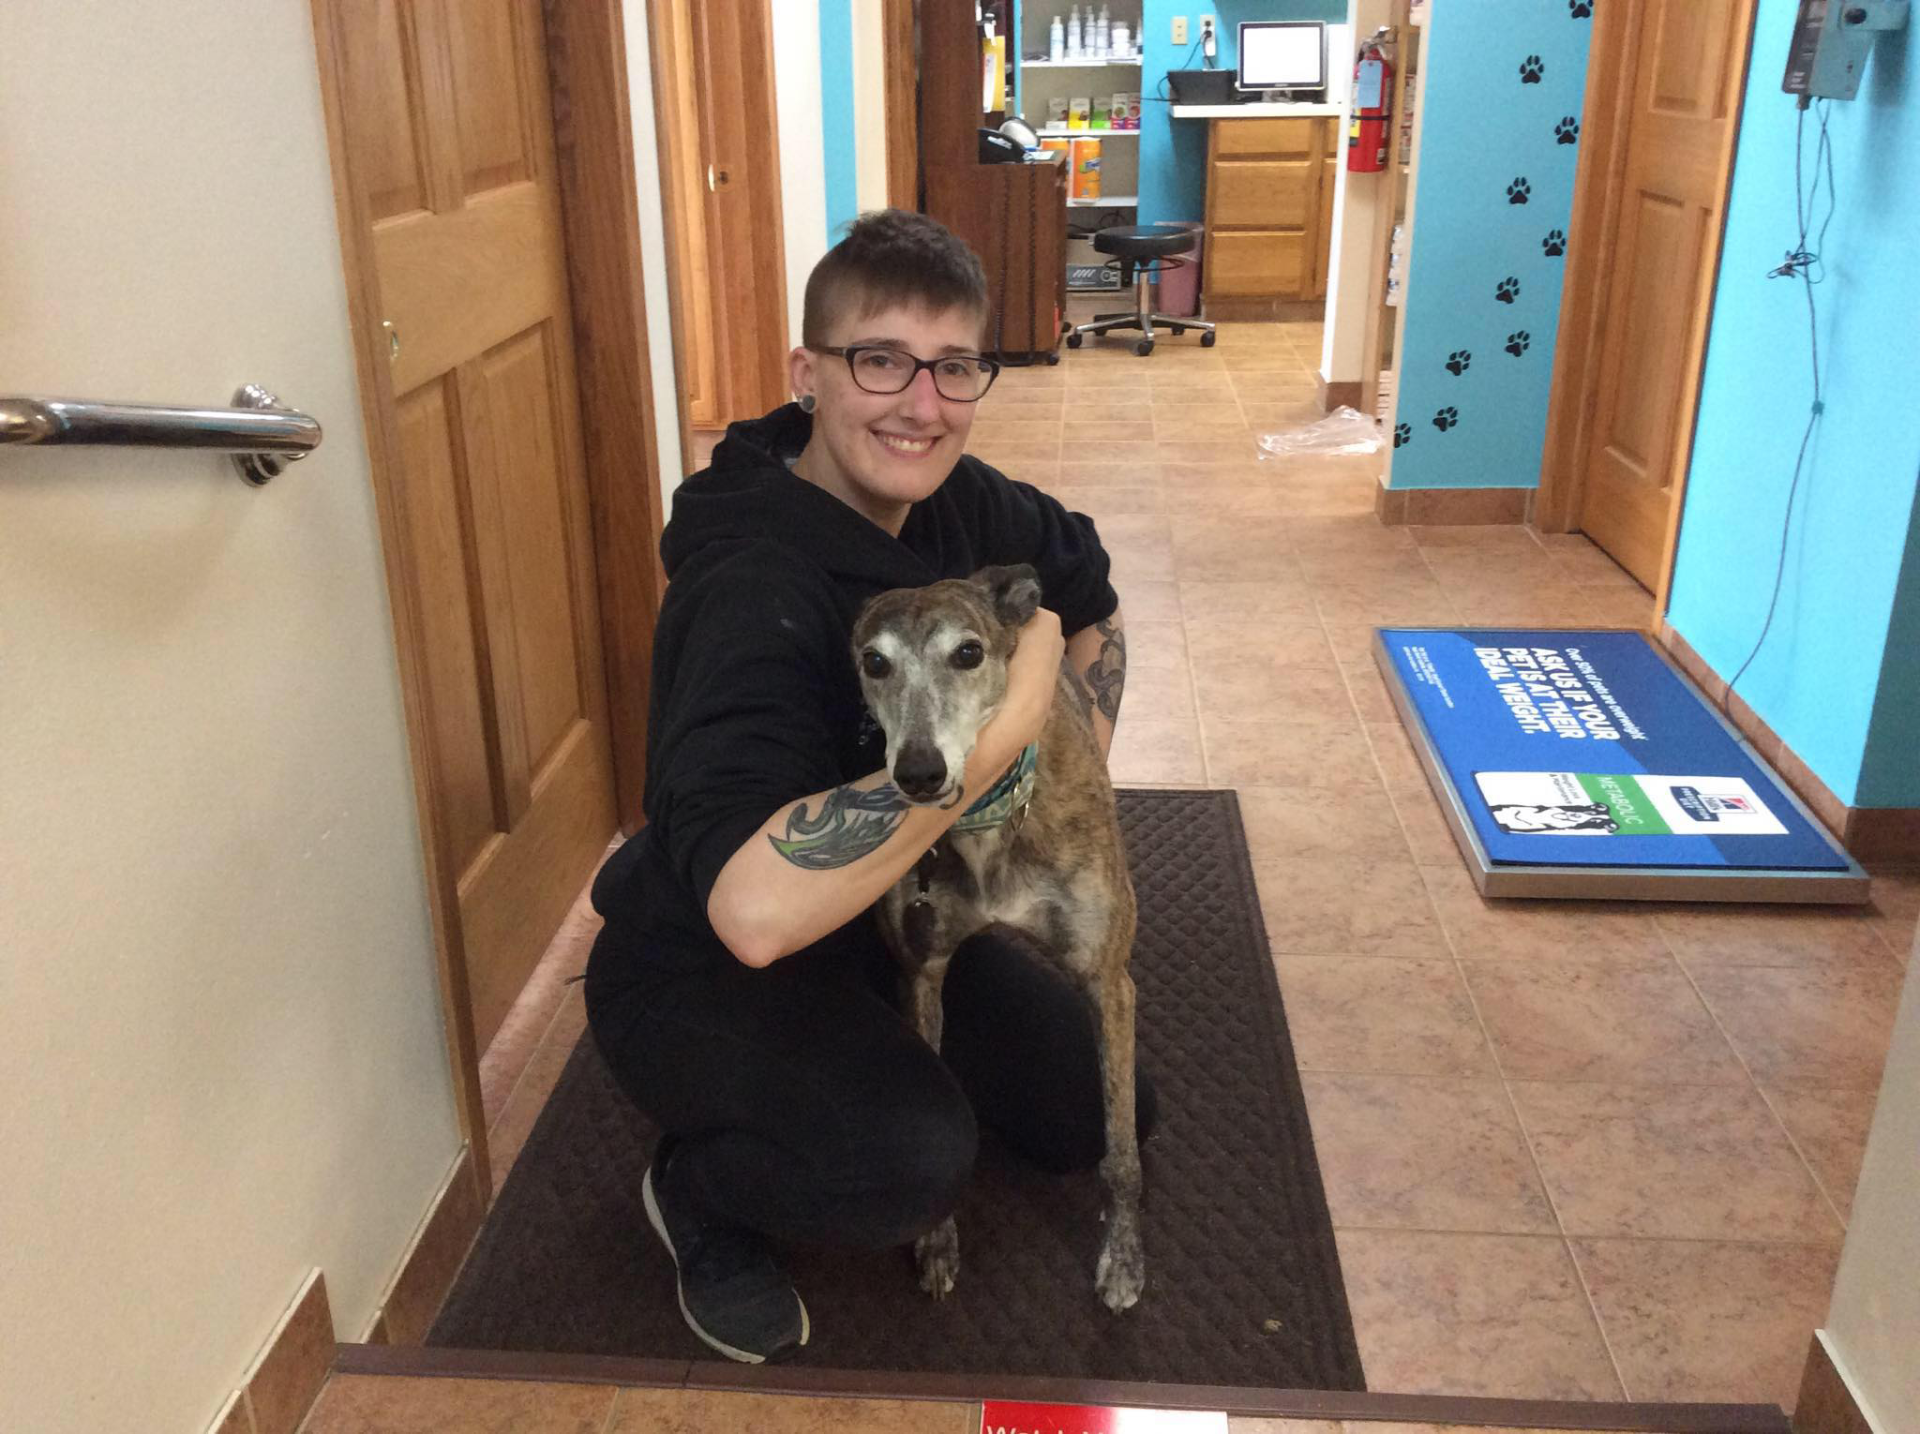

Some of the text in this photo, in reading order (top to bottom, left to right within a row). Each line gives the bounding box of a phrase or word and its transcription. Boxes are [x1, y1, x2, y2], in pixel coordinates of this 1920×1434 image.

[1474, 647, 1551, 734] IDEAL WEIGHT.
[1502, 648, 1586, 738] PET IS AT THEIR
[1530, 648, 1620, 740] ASK US IF YOUR
[1565, 648, 1583, 661] Over
[1587, 681, 1609, 694] pets
[1600, 694, 1617, 705] are
[1598, 777, 1643, 824] METABOLIC
